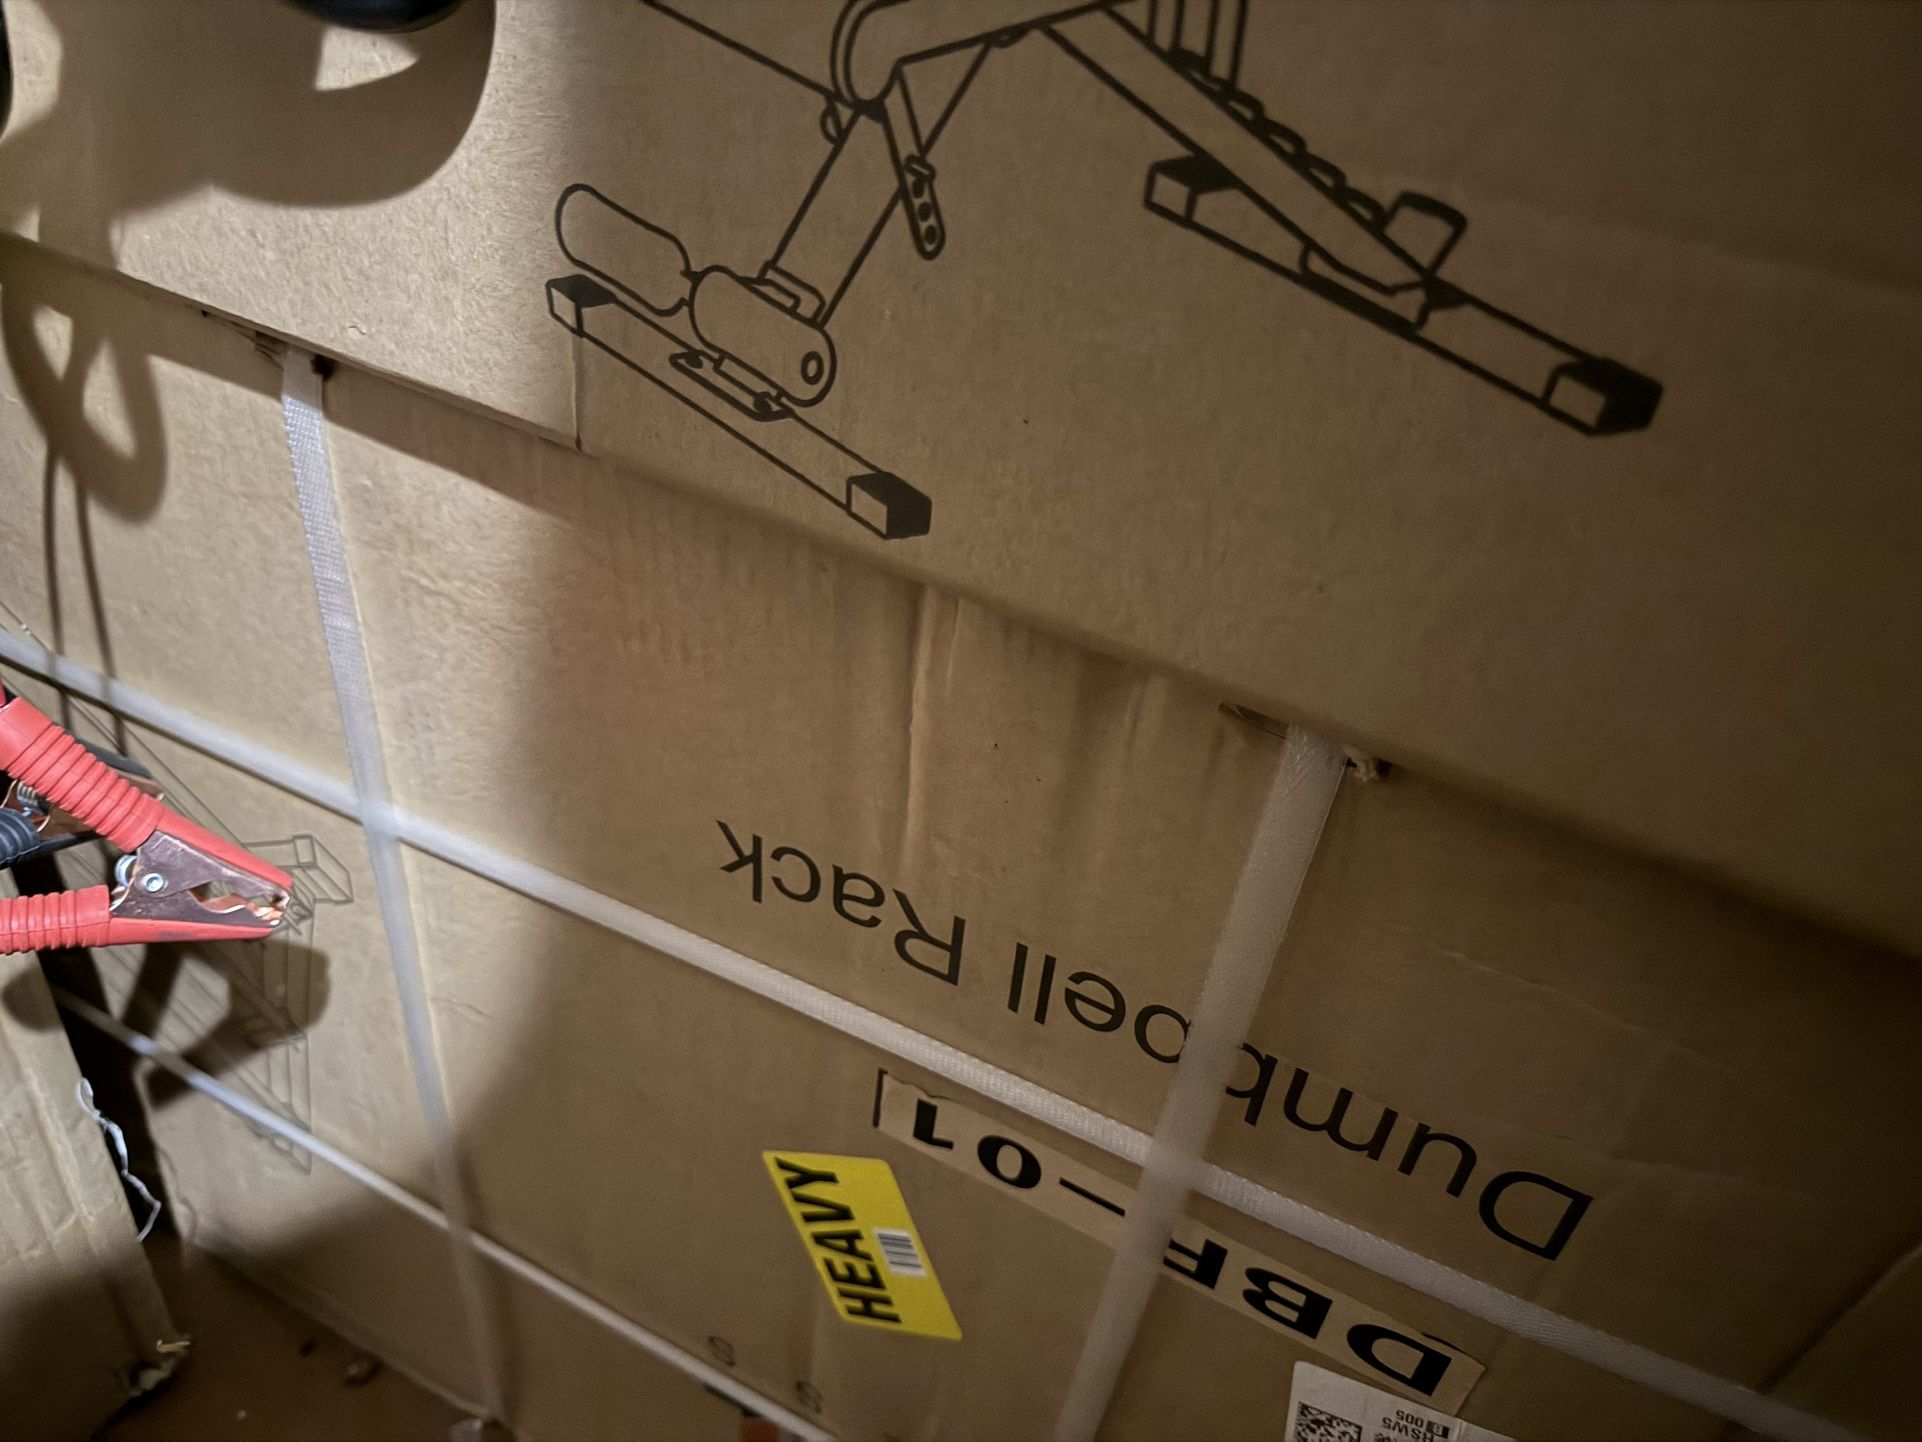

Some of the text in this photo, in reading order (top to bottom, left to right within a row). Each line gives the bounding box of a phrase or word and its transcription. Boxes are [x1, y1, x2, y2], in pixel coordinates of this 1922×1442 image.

[716, 818, 1595, 1261] Dumbbell Rack
[773, 1155, 903, 1324] HEAVY
